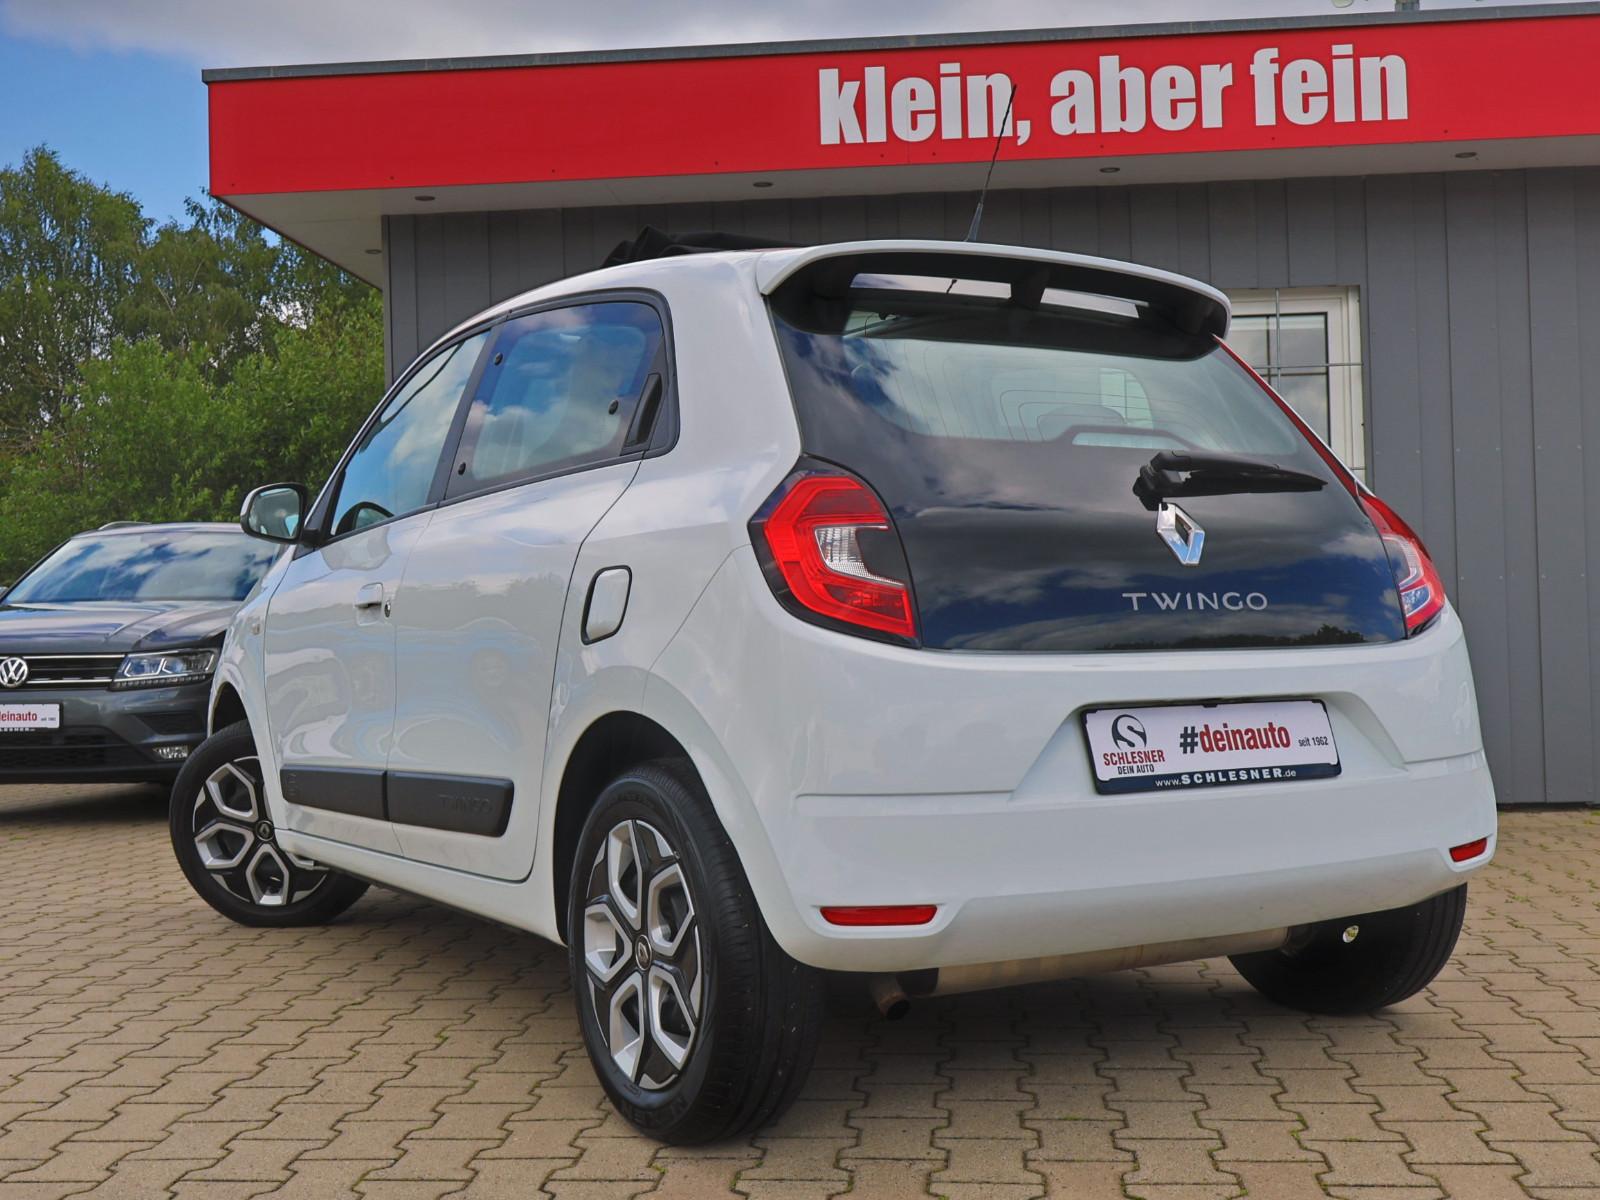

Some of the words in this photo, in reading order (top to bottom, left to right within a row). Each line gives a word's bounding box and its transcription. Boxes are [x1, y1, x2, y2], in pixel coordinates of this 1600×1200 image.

[818, 62, 1031, 146] klein,
[1050, 54, 1233, 136] aber
[1250, 43, 1408, 126] fein
[1122, 592, 1268, 611] TWINGO
[0, 710, 37, 721] einauto
[1180, 722, 1291, 754] #deinauto
[1298, 737, 1311, 747] seit
[1313, 736, 1328, 746] 1962
[1103, 750, 1165, 766] SCHLESNER
[1118, 765, 1134, 775] DEIN
[1137, 764, 1155, 774] AUTO
[1155, 768, 1296, 787] www.SCHLESNER.de
